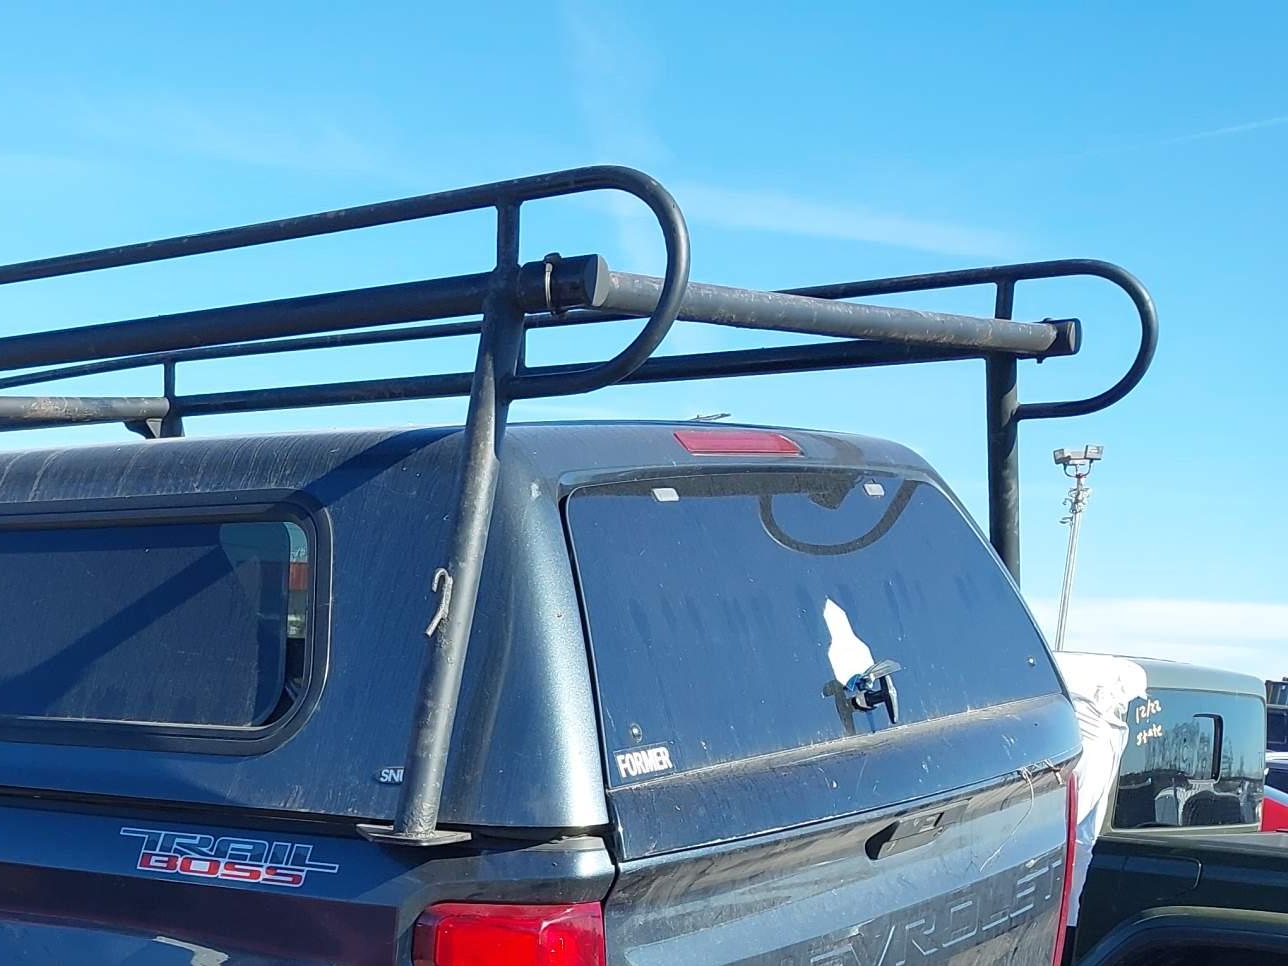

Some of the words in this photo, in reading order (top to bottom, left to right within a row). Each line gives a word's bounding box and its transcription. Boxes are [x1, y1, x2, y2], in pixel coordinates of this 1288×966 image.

[616, 746, 673, 778] FORMER
[120, 827, 339, 873] TRAIL
[137, 852, 308, 888] BOSS
